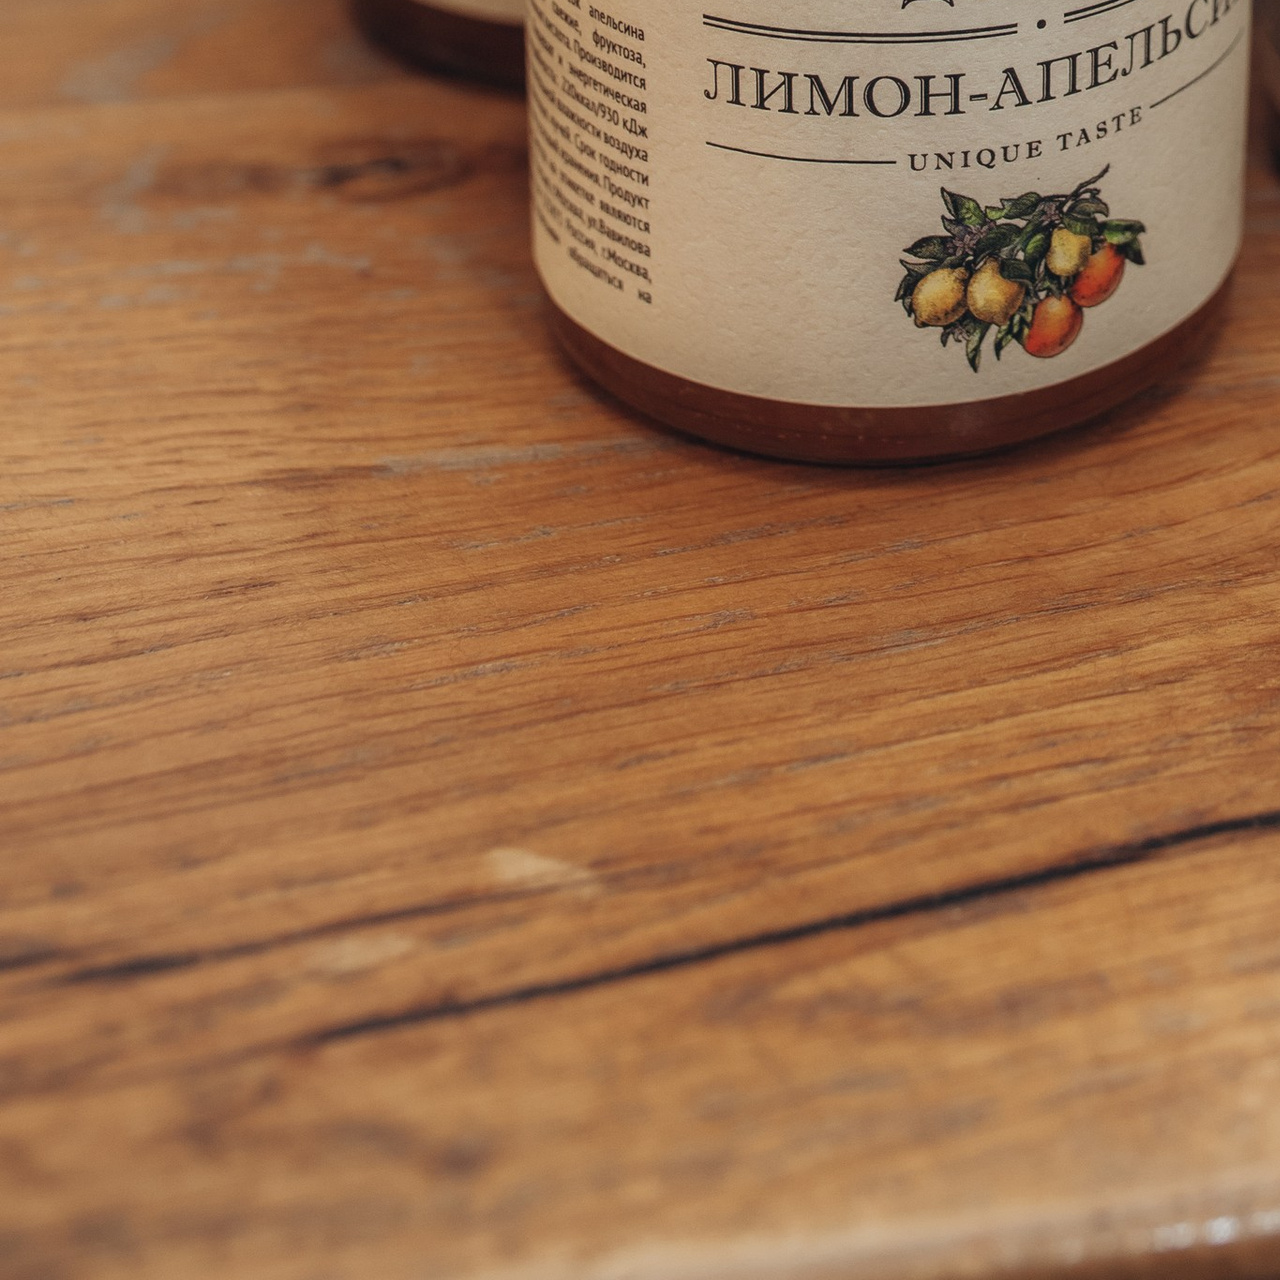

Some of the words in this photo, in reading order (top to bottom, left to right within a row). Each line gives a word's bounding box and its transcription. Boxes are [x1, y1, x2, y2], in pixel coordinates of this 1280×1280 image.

[588, 4, 646, 42] апельсина
[573, 37, 647, 91] Производится
[592, 27, 647, 69] фруктоза,
[568, 61, 647, 115] энергетическая
[603, 131, 649, 163] воздуха
[622, 117, 649, 140] кДж
[908, 139, 1044, 172] UNIQUE
[1056, 105, 1144, 152] TASTE
[574, 132, 597, 161] Срок
[599, 152, 650, 188] годности
[603, 173, 650, 210] Продукт
[637, 288, 652, 305] на
